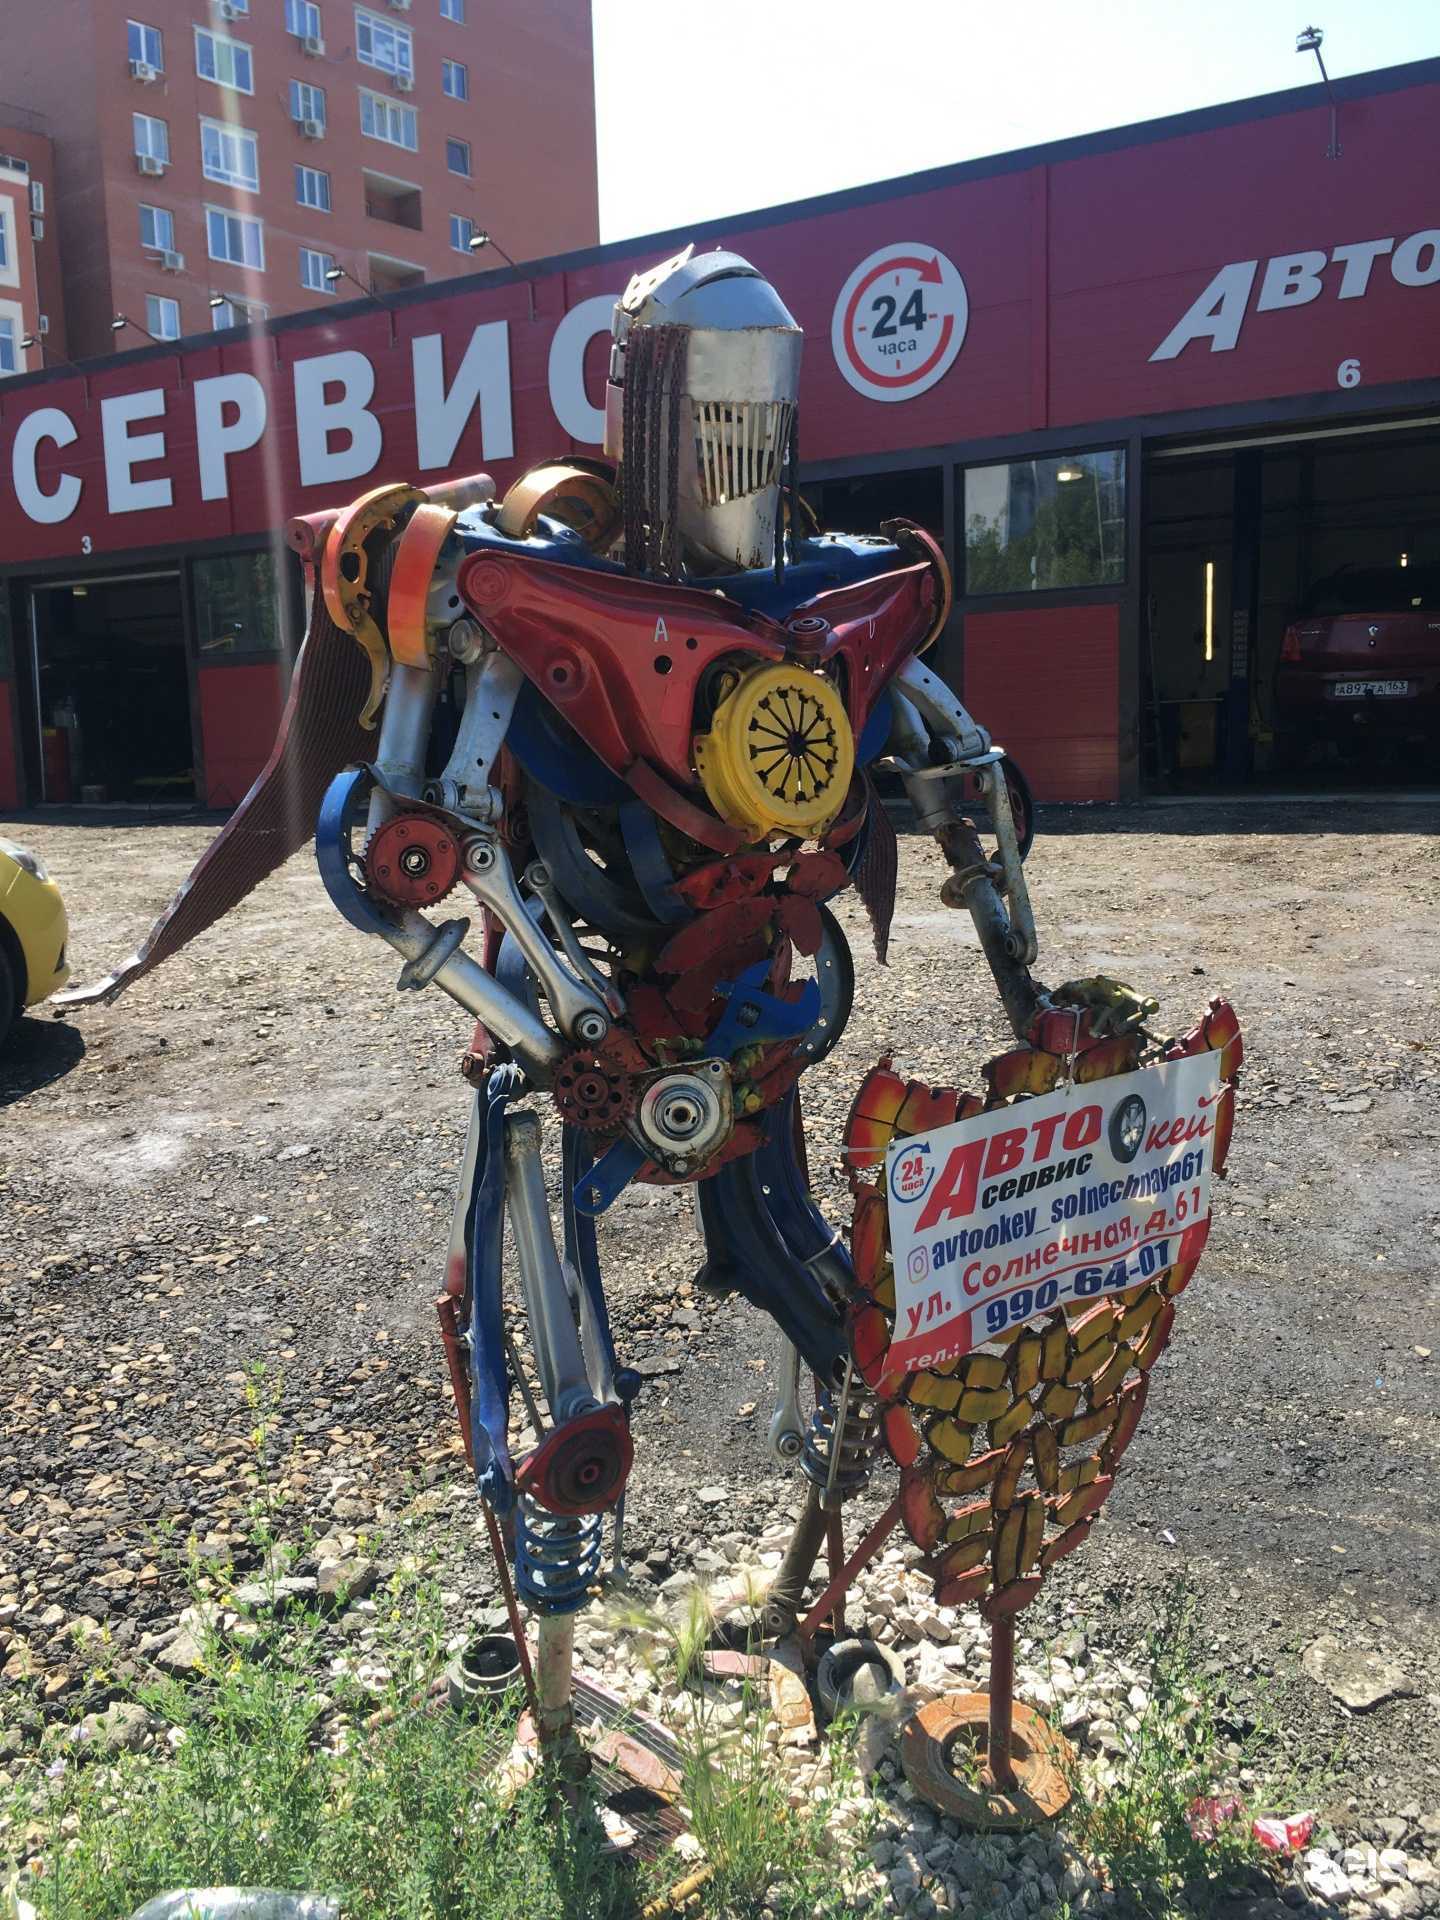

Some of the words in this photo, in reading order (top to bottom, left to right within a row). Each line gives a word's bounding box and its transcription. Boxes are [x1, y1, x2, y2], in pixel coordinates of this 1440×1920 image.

[871, 288, 927, 339] 24
[878, 338, 917, 355] часа
[1337, 359, 1360, 388] 6
[12, 294, 620, 523] СЕРВИС
[82, 536, 92, 554] 3
[902, 1156, 923, 1182] 24
[902, 1179, 924, 1192] часа
[914, 1105, 1103, 1233] АВТО
[982, 1153, 1093, 1209] сервис
[906, 1291, 951, 1337] ул.
[963, 1216, 1139, 1296] Солнечная,
[986, 1239, 1170, 1333] 990-64-01
